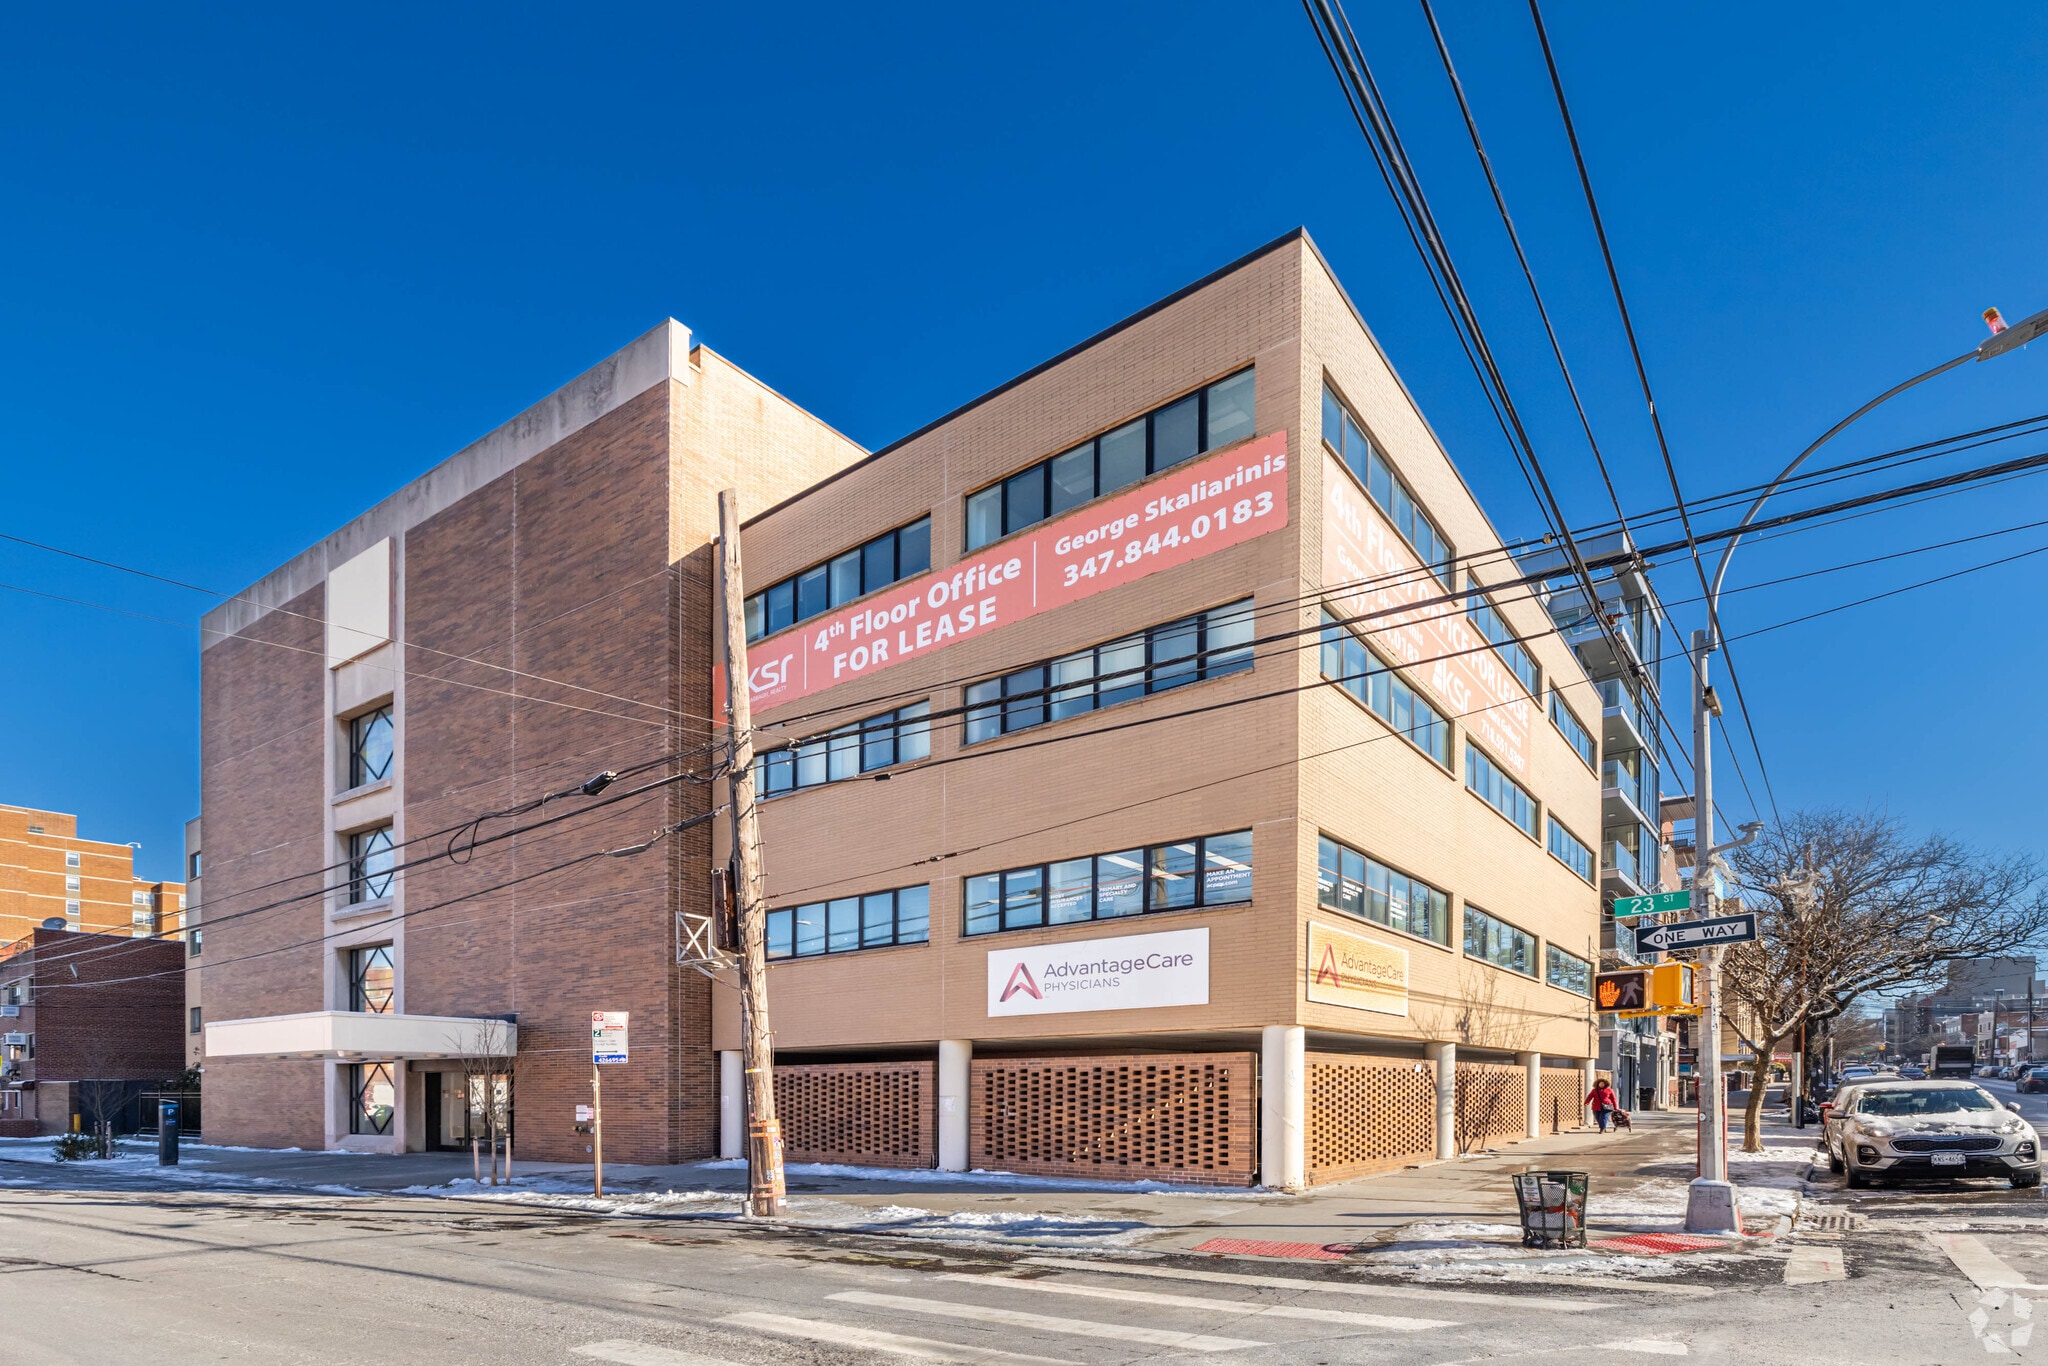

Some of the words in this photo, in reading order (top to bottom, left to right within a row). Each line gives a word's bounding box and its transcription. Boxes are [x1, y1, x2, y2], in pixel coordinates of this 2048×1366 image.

[1055, 513, 1139, 556] George
[1145, 454, 1287, 522] Skaliarinis
[1063, 491, 1273, 587] 347.844.0183
[814, 620, 845, 652] 4th
[850, 597, 921, 641] Floor
[927, 557, 1022, 609] Office
[1330, 482, 1362, 541] 4th
[1471, 641, 1495, 692] FOR
[1497, 672, 1529, 729] LEASE
[833, 638, 889, 679] FOR
[899, 596, 997, 656] LEASE
[1099, 885, 1122, 893] PRIMARY
[1206, 872, 1251, 882] APPOINTMENT
[1099, 889, 1128, 898] SPECIALTY
[1630, 897, 1655, 914] 23
[1663, 894, 1674, 903] ST
[1653, 931, 1686, 944] ONE
[1702, 924, 1739, 938] WAY
[1044, 953, 1194, 978] AdvantageCare
[1341, 952, 1404, 982] AdvantageCare
[1044, 977, 1120, 992] PHYSICIANS
